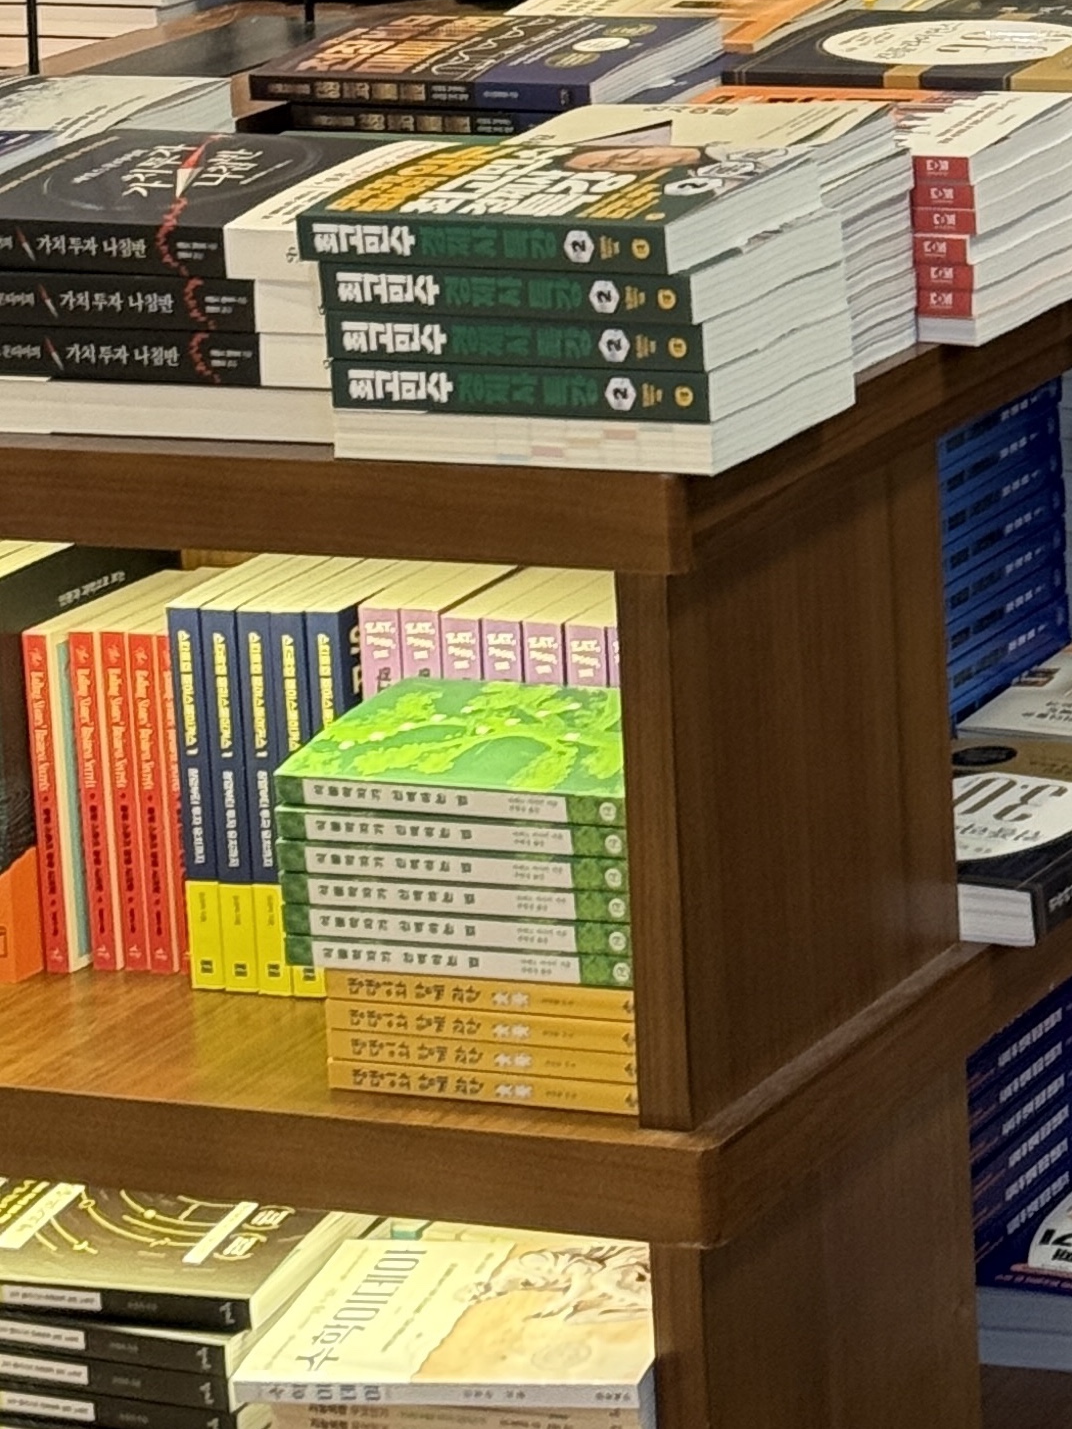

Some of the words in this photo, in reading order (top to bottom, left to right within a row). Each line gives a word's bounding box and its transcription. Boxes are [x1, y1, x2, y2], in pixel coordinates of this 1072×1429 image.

[103, 236, 147, 259] 나침반
[313, 223, 415, 257] 최고민수
[570, 239, 587, 254] 2
[128, 292, 174, 315] 나침반
[336, 272, 440, 306] 최고민수
[596, 289, 612, 304] 2
[342, 321, 447, 355] 최고민수
[606, 338, 622, 352] 2
[134, 346, 180, 368] 나침반
[348, 370, 453, 403] 최고민수
[612, 387, 628, 402] 2
[295, 1249, 427, 1371] 수학이데아
